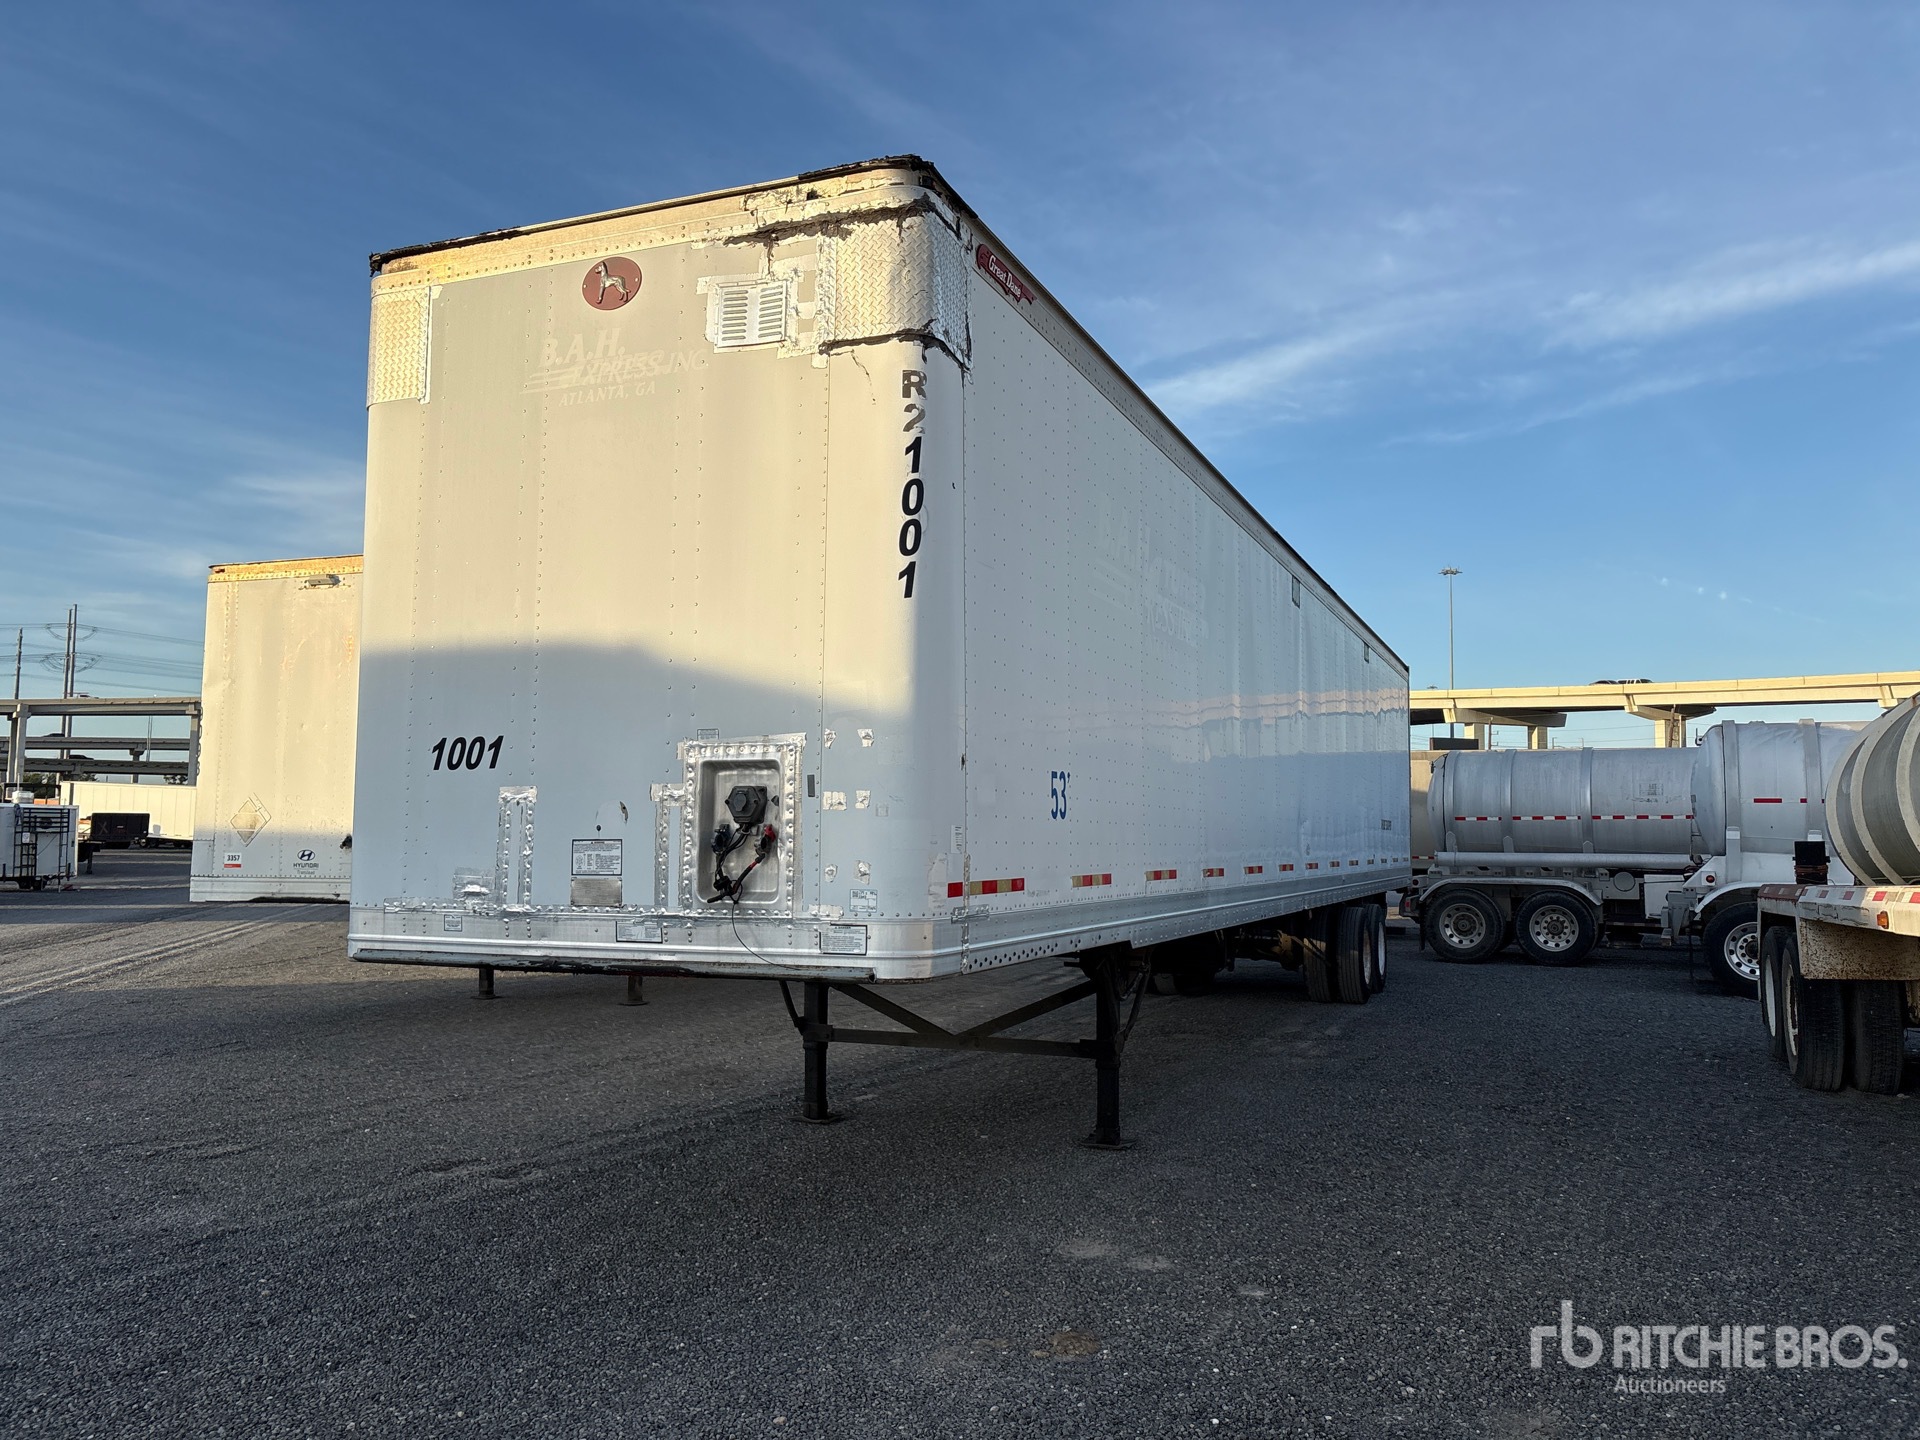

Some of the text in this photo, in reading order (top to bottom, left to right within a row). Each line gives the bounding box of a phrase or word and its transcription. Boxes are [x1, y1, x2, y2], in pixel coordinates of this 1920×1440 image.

[988, 254, 1022, 298] Great Dane
[634, 381, 656, 397] GA
[432, 735, 504, 771] 1001
